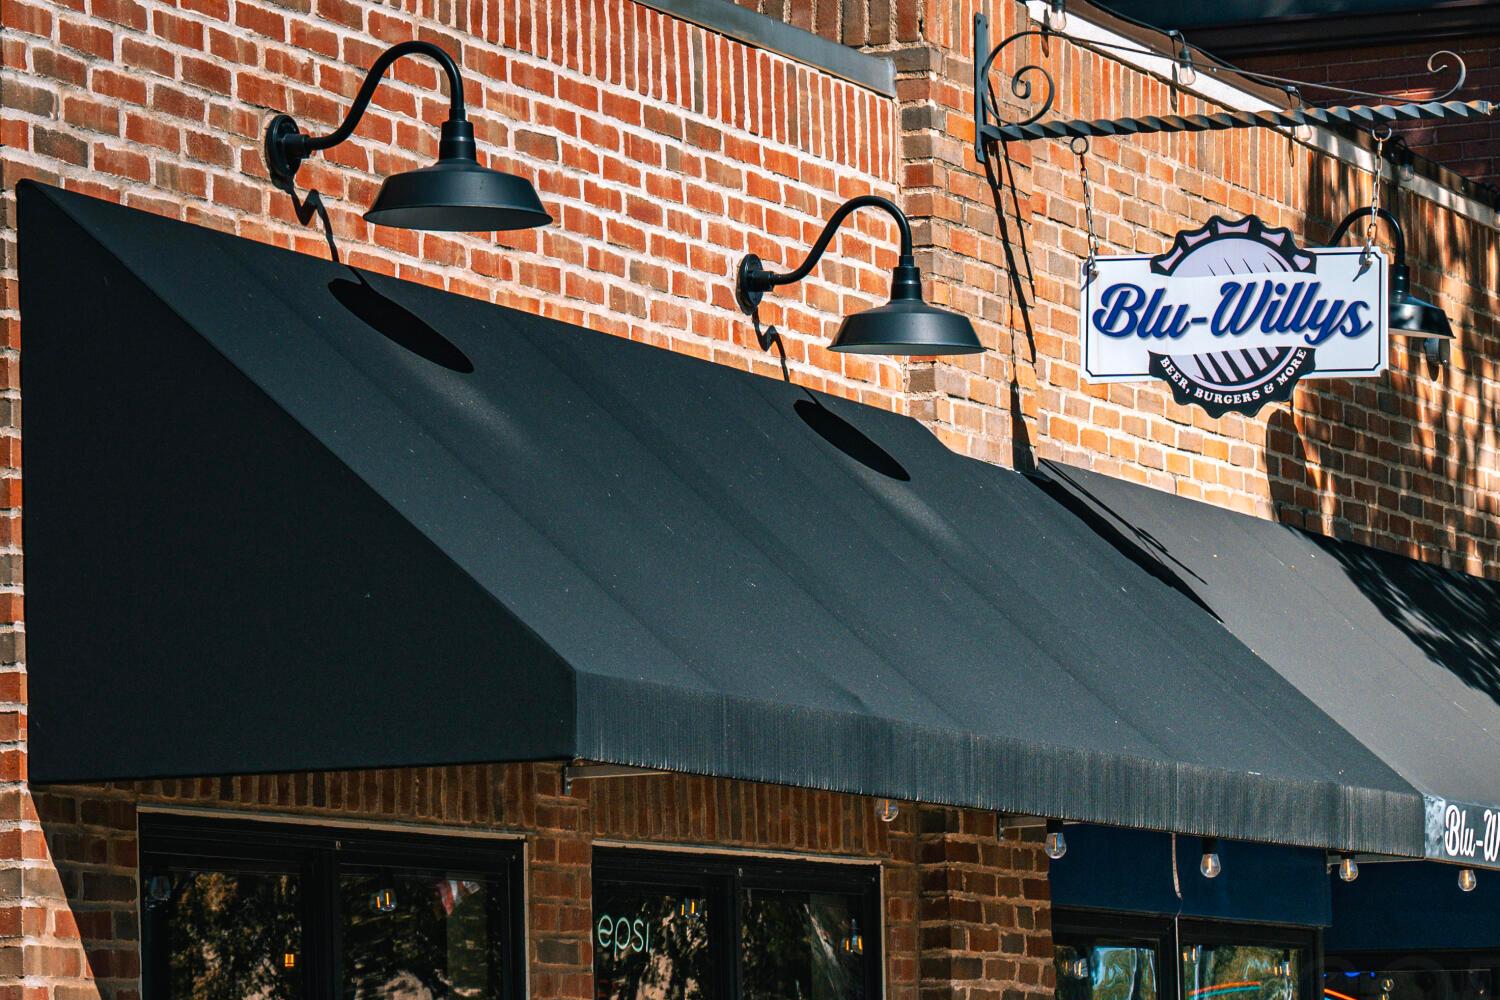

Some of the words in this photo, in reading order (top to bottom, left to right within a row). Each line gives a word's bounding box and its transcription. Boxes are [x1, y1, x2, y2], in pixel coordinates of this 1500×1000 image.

[1092, 279, 1373, 346] Blu-Willys
[1160, 355, 1191, 394] BEER,
[1194, 386, 1261, 404] BURGERS
[1264, 382, 1275, 394] &
[1278, 349, 1307, 386] MORE
[597, 914, 650, 961] epsi
